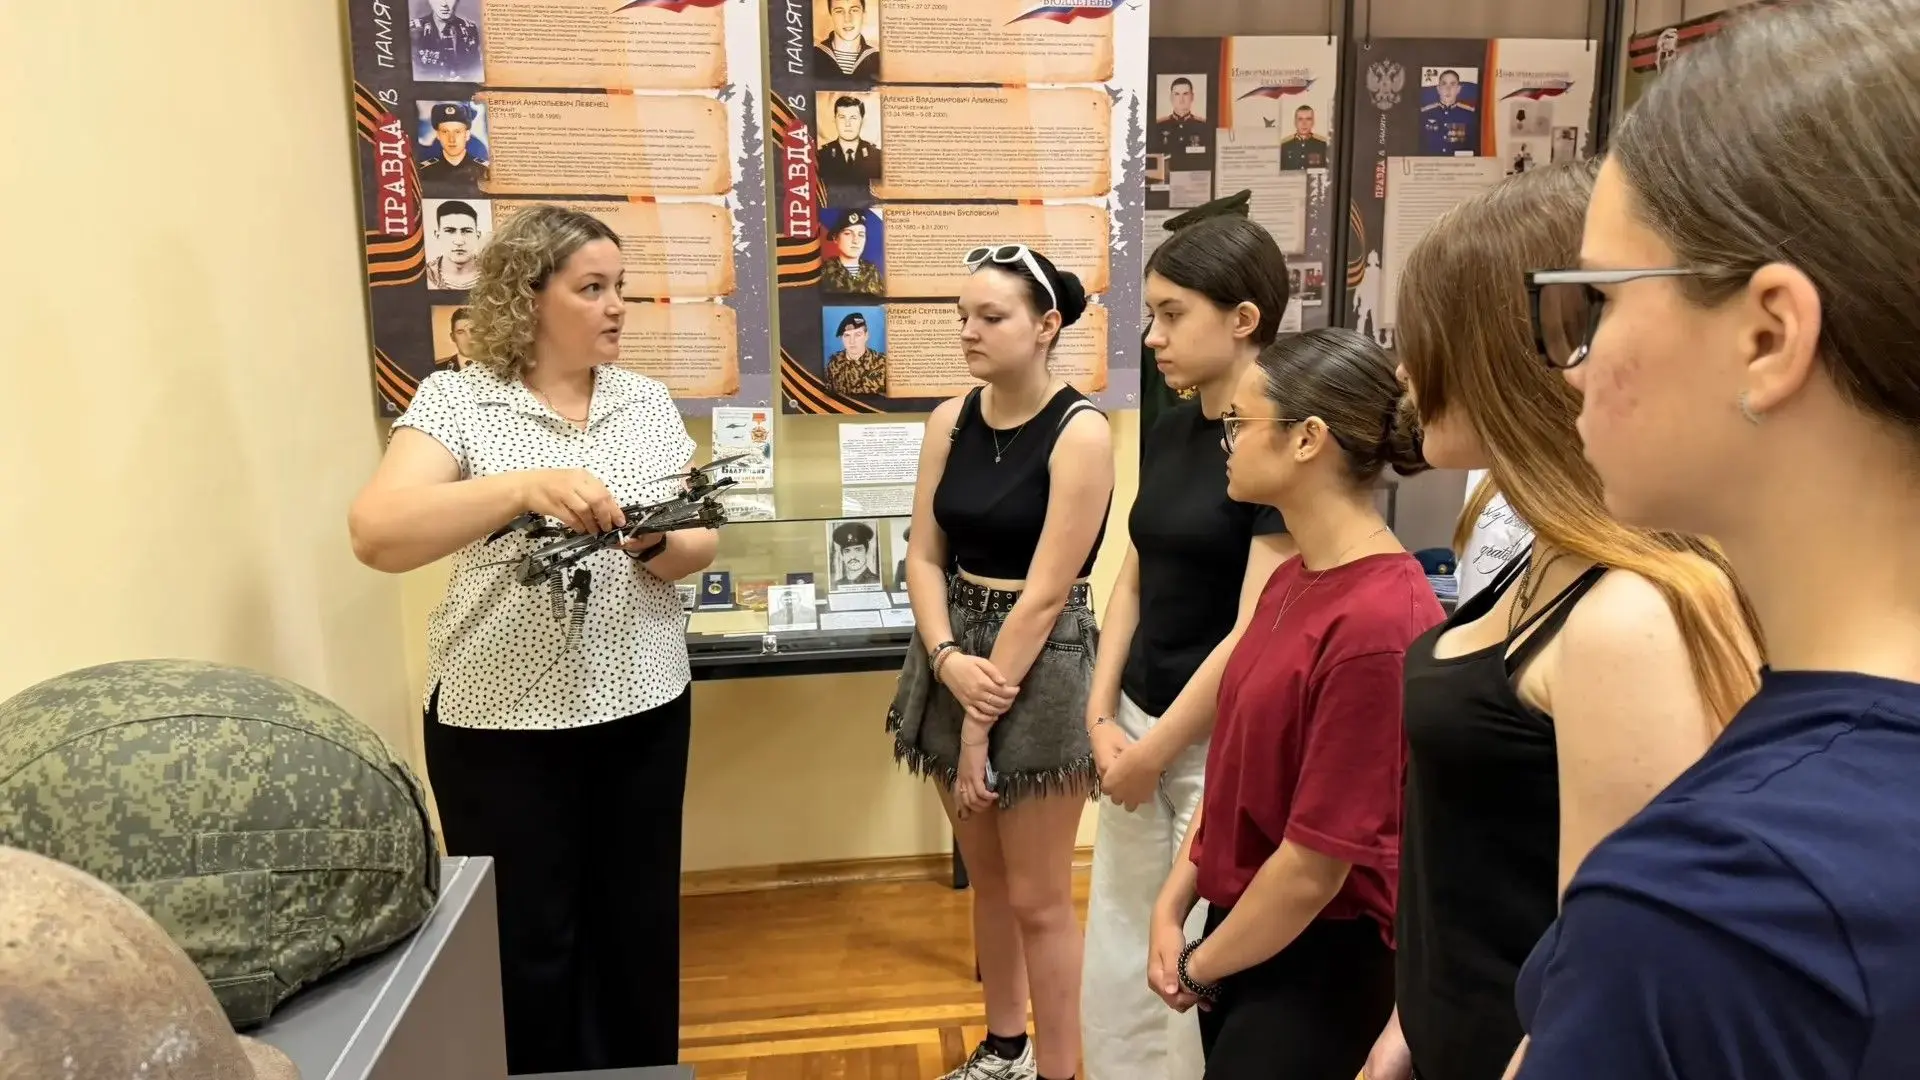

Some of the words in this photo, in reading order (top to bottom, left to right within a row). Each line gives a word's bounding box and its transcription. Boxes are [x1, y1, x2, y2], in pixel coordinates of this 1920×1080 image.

[373, 0, 395, 68] ПАМЯ
[380, 119, 409, 235] ПРАВДА
[495, 203, 518, 211] ГРИГО
[788, 125, 813, 237] ПРАВДА
[912, 209, 956, 217] НИКОЛАЕВИЧ
